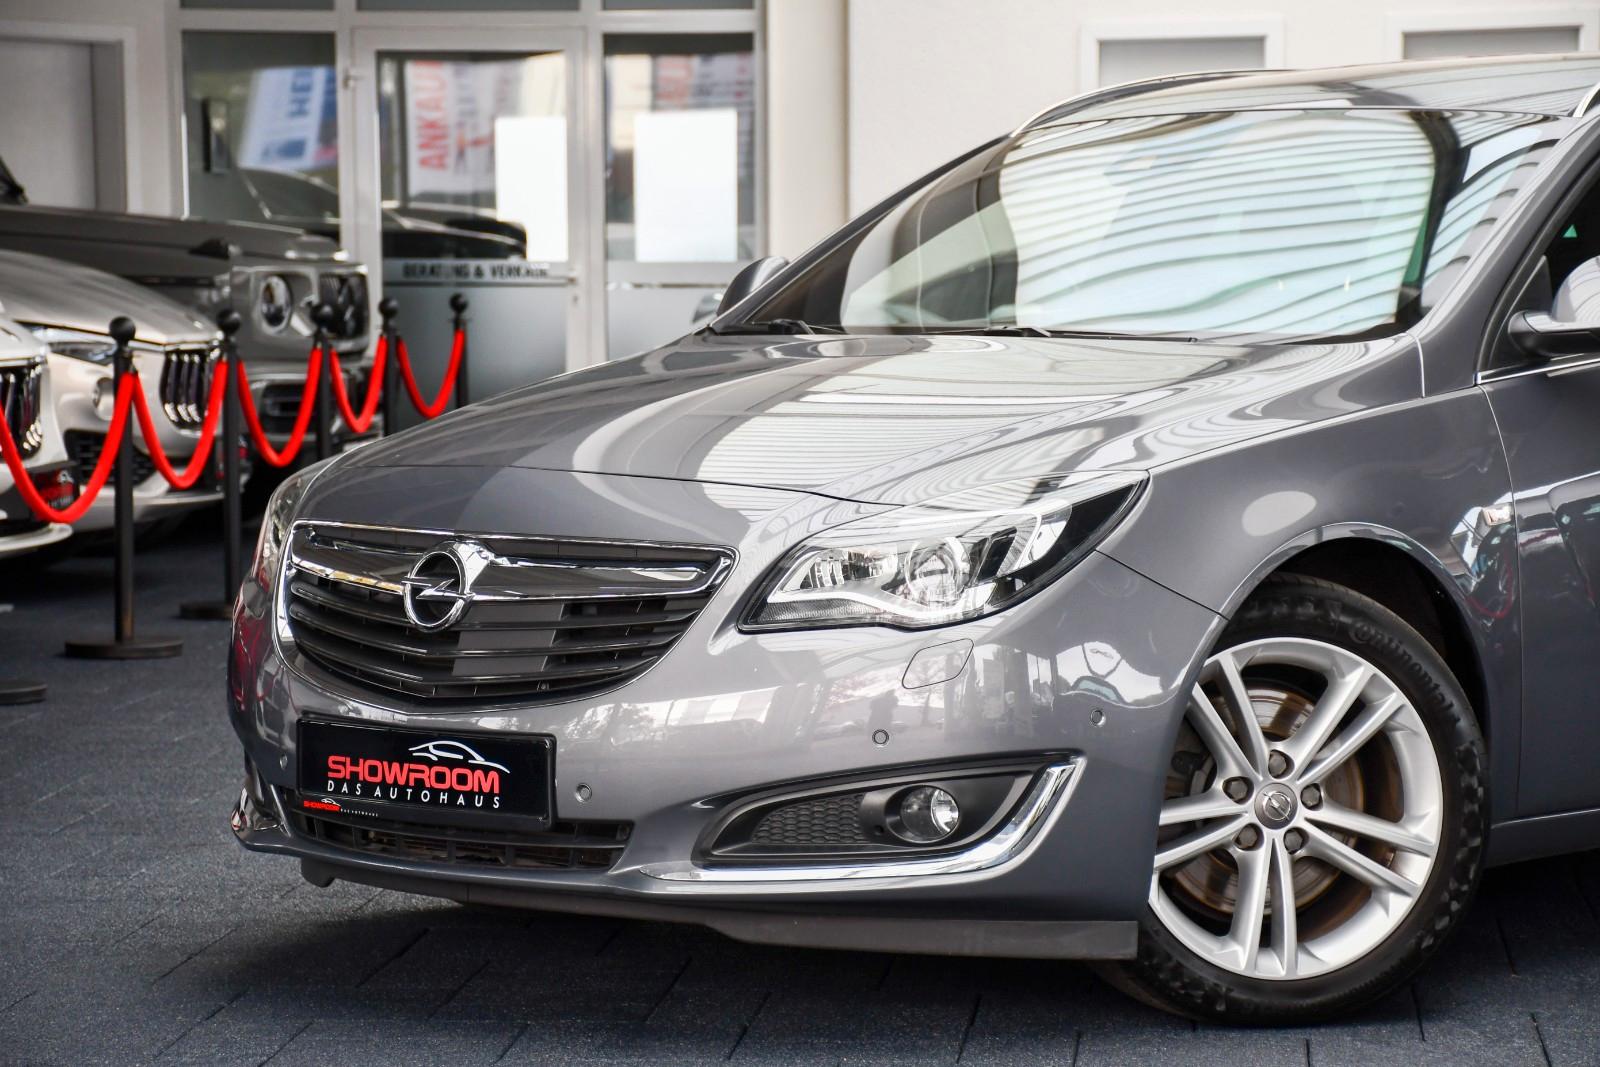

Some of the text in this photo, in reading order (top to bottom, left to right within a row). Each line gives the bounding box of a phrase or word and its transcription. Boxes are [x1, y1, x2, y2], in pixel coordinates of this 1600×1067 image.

[327, 755, 500, 794] SHOWROOM
[327, 780, 500, 809] DAS AUTOHAUS
